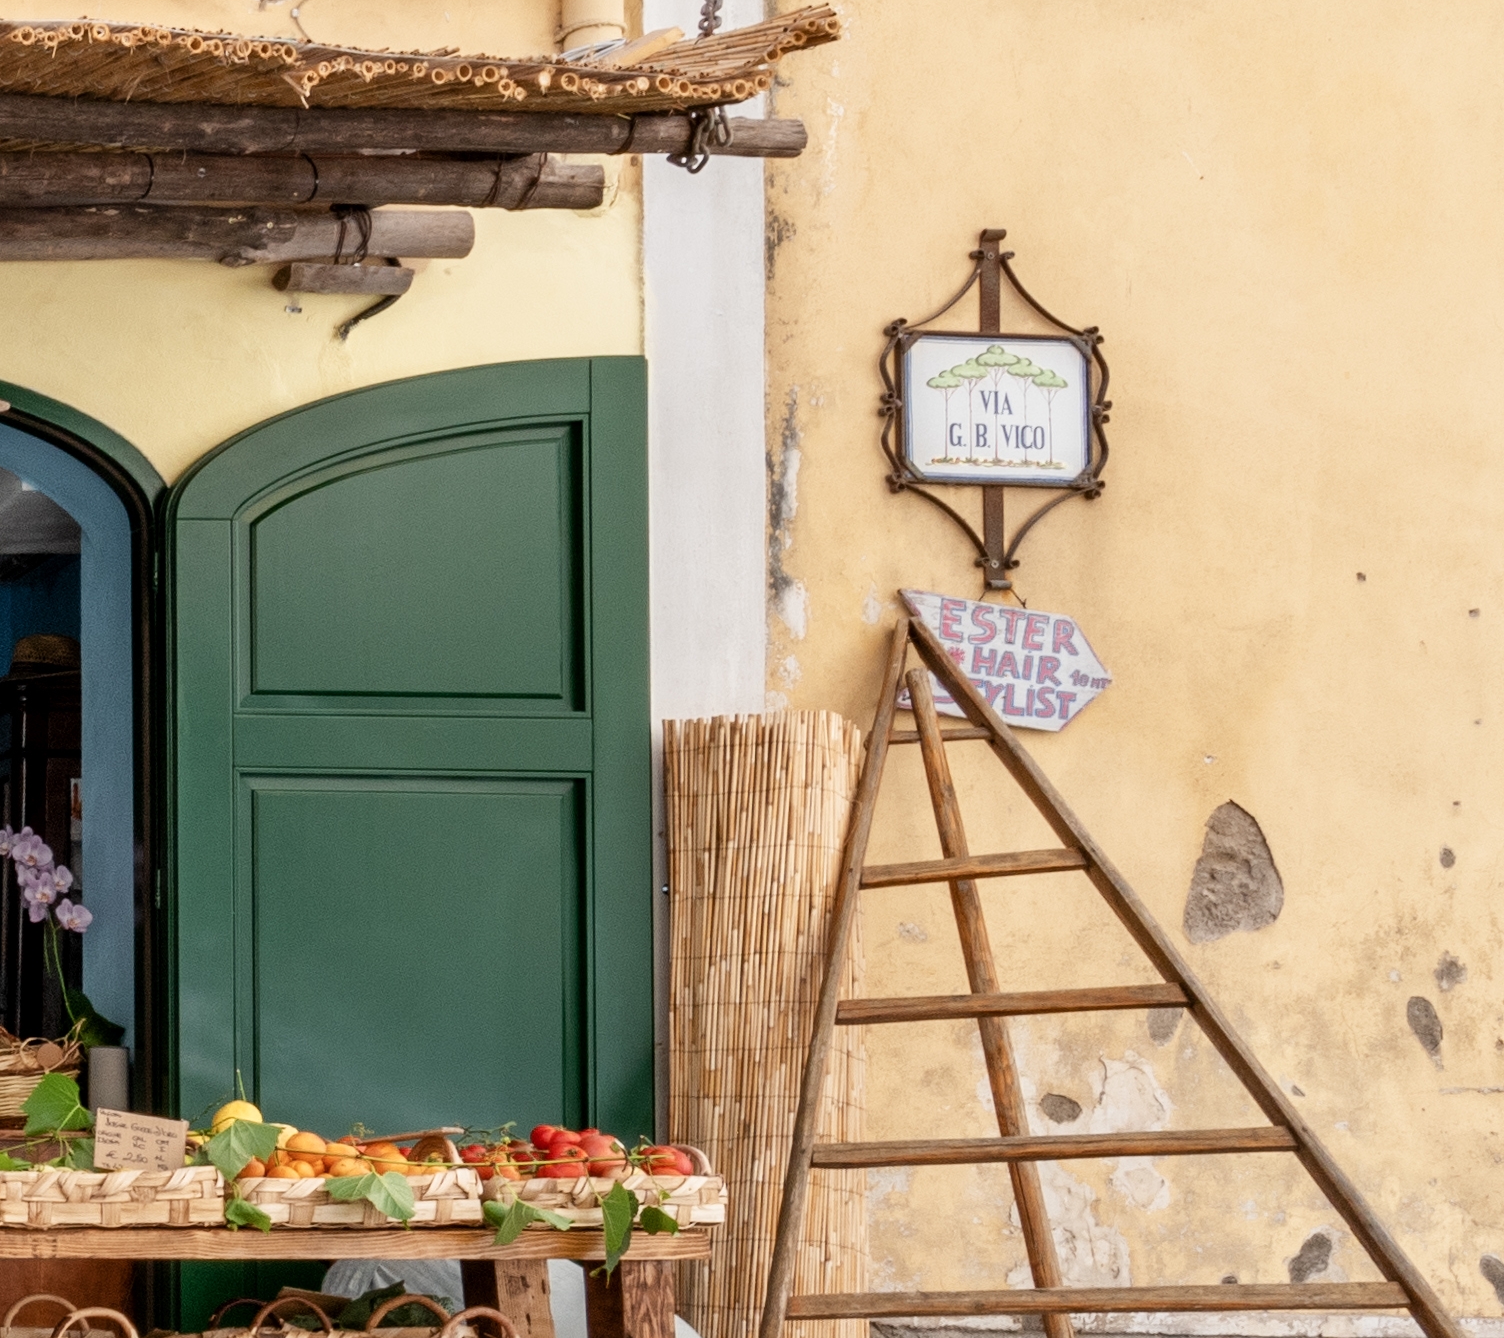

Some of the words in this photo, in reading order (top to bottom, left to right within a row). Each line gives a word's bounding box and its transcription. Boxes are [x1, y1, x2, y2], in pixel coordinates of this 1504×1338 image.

[979, 389, 1013, 416] VIA
[949, 422, 967, 448] G.
[975, 422, 991, 449] B.
[1001, 423, 1046, 451] VICO
[938, 597, 1079, 656] ESTER
